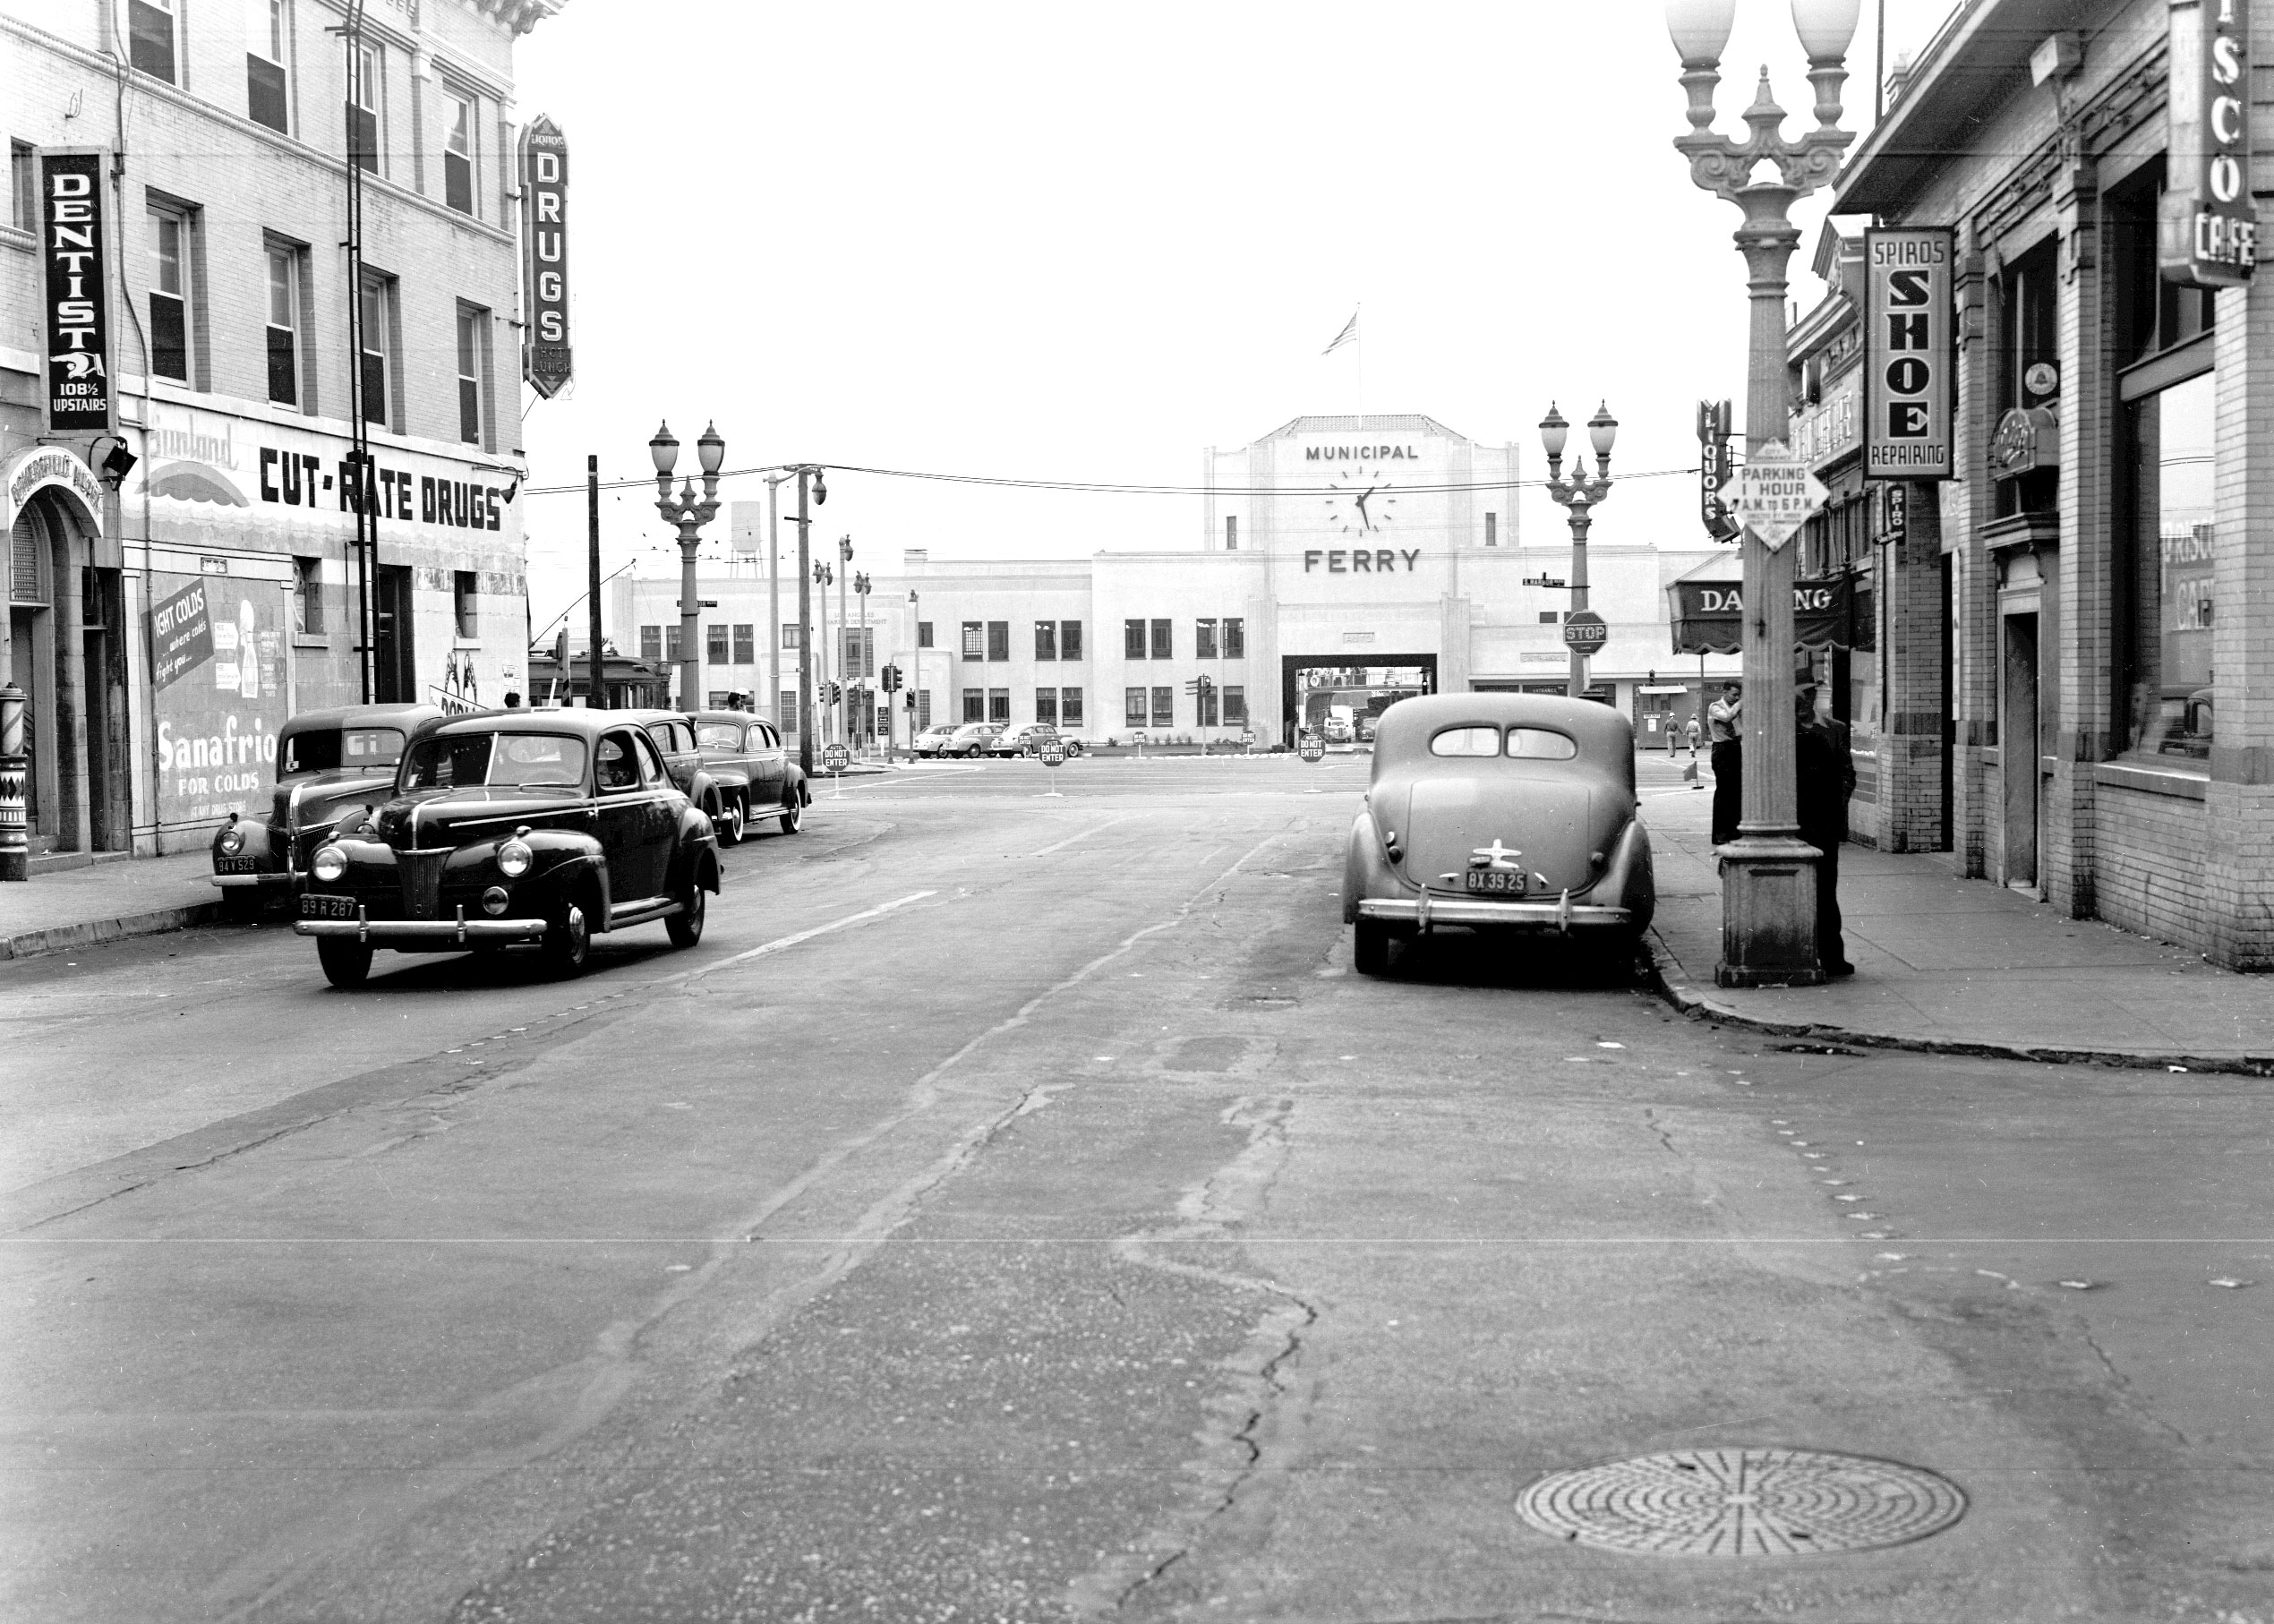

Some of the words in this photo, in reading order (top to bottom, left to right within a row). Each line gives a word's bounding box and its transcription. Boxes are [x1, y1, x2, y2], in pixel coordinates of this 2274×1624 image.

[537, 151, 562, 341] DRUGS
[2195, 211, 2254, 266] CAFE
[52, 175, 96, 349] DENTIST
[1874, 241, 1945, 266] SPIROS
[540, 346, 564, 358] HOT
[1884, 269, 1931, 440] SHOE
[532, 361, 571, 372] LUNCH
[53, 398, 107, 412] UPSTAIRS
[1306, 445, 1419, 460] MUNICIPAL
[1870, 445, 1945, 466] REPAIRING
[1704, 412, 1718, 520] LIQUORS
[1741, 467, 1806, 481] PARKING
[260, 446, 413, 521] CUT-RATE
[422, 475, 500, 532] DRUGS
[1759, 483, 1806, 496] HOUR
[1304, 548, 1421, 573] FERRY
[175, 587, 205, 624] COLDS
[1700, 588, 1833, 611] DANG
[192, 620, 207, 638] colds
[1566, 626, 1605, 640] STOP
[156, 660, 174, 682] fight
[158, 714, 278, 772] Sanafrio
[1041, 745, 1050, 753] DO
[1051, 745, 1064, 753] NOT
[1301, 740, 1309, 748] DO
[1310, 740, 1322, 748] NOT
[825, 758, 847, 766] ENTER
[178, 777, 209, 796] FOR
[214, 772, 260, 793] COLDS
[211, 803, 227, 816] DRUG
[238, 859, 254, 871] 529
[1468, 872, 1485, 888] 8X
[1488, 873, 1505, 889] 39
[1508, 874, 1525, 891] 25
[331, 902, 355, 917] 287
